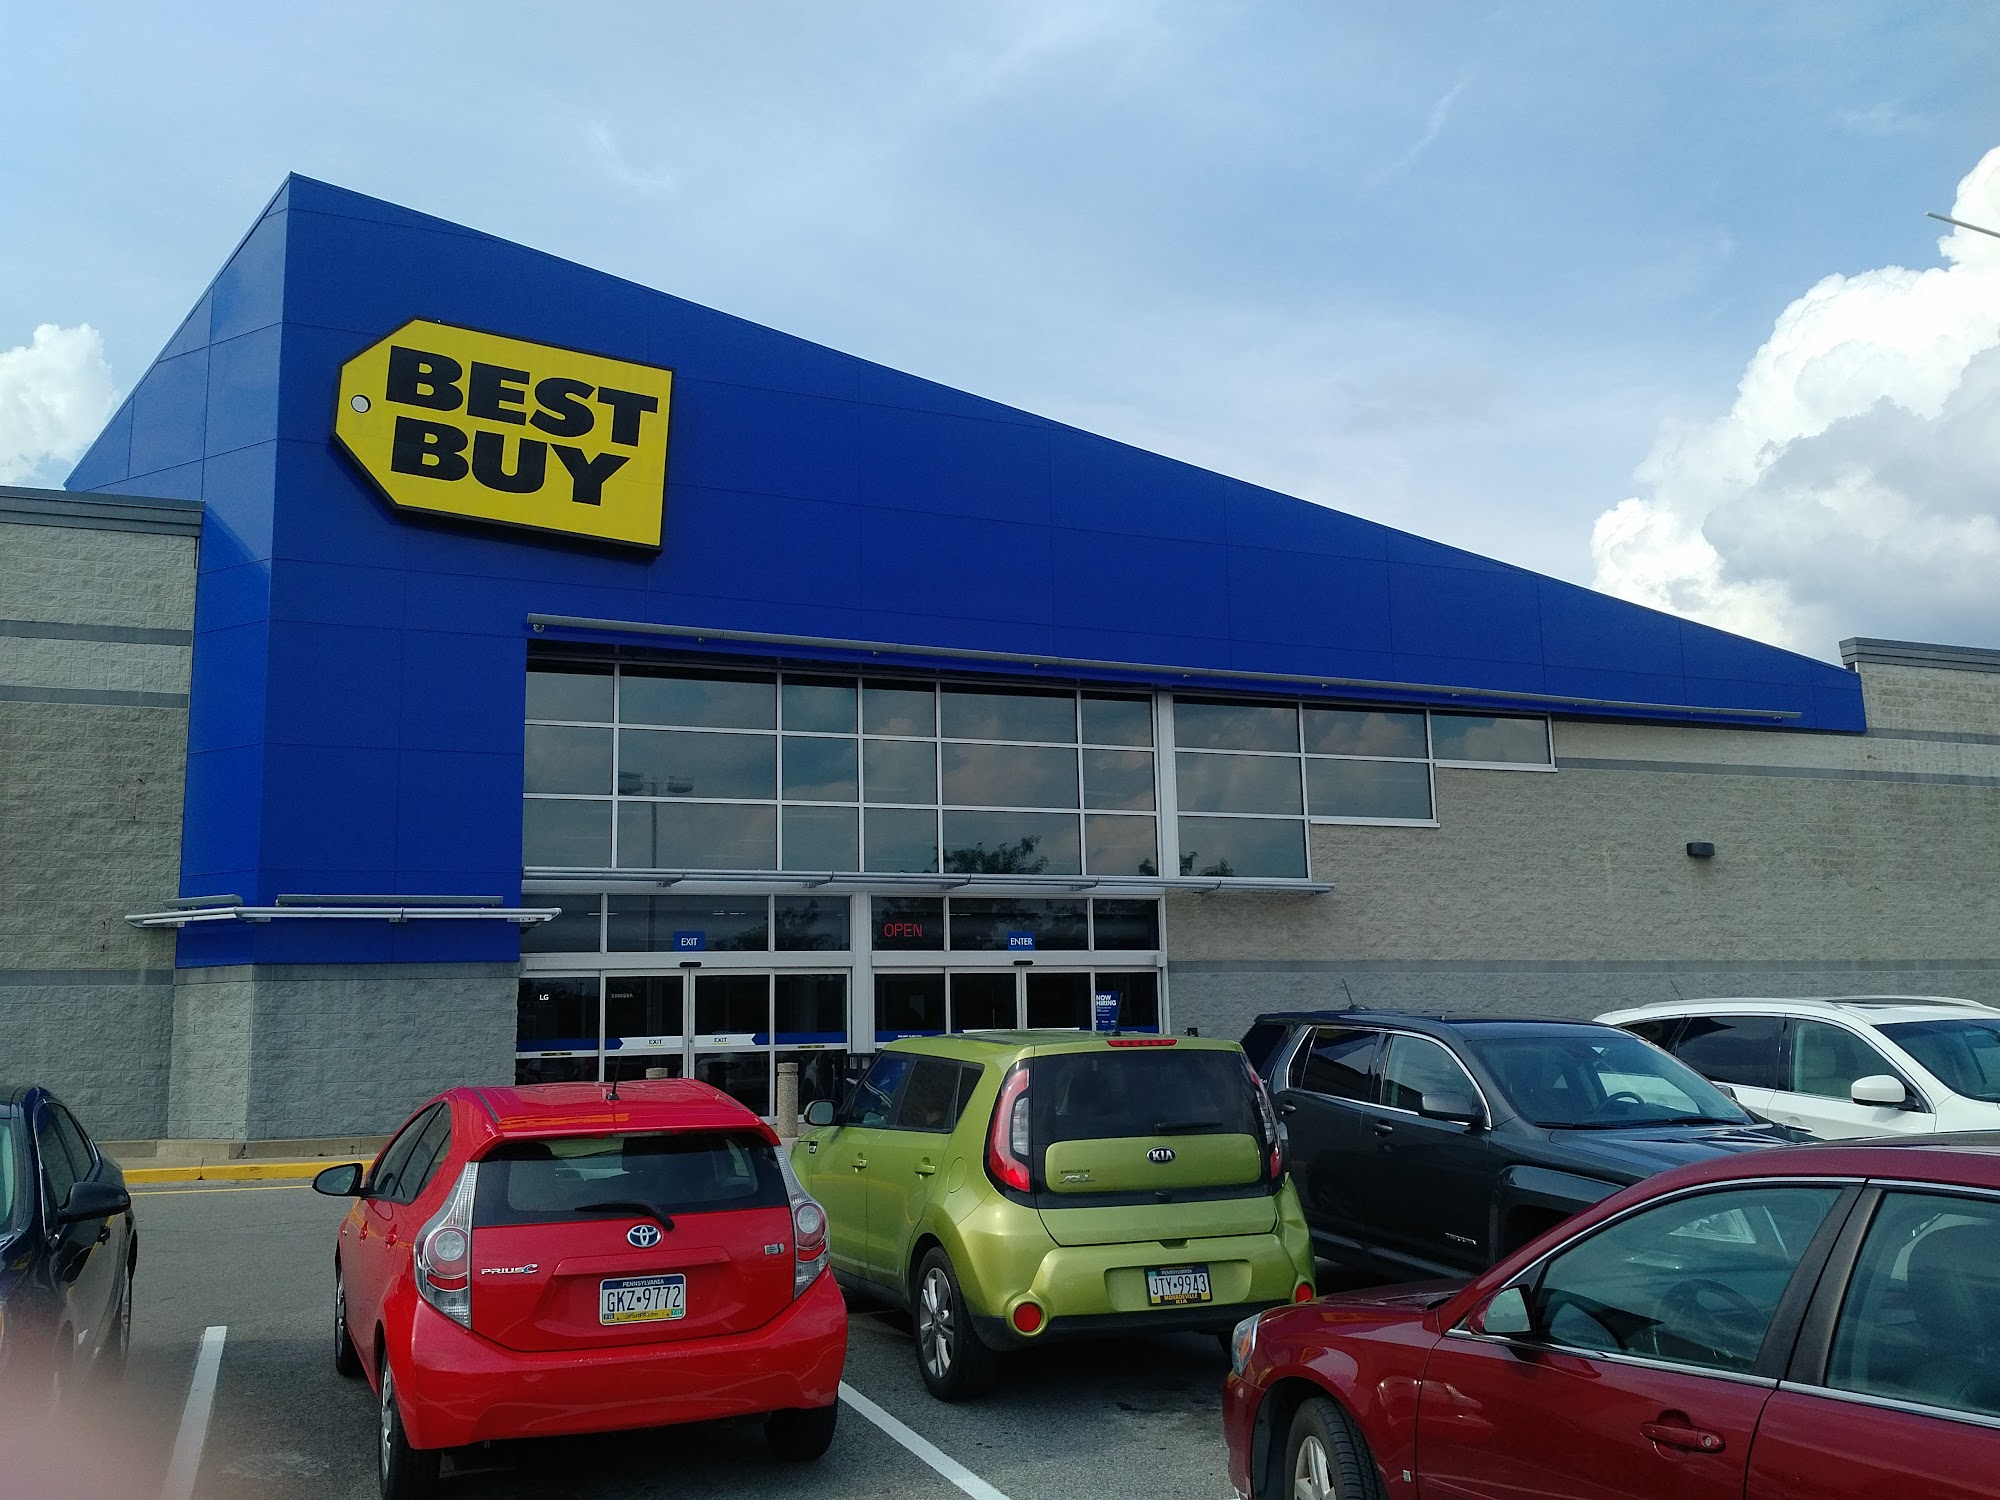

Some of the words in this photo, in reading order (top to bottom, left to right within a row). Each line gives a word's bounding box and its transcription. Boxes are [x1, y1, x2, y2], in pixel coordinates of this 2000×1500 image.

[385, 344, 659, 447] BEST
[390, 415, 631, 507] BUY
[884, 923, 923, 937] OPEN
[681, 937, 698, 946] EXIT
[1010, 937, 1033, 946] ENTER
[1152, 1150, 1173, 1161] KIA
[622, 1278, 665, 1288] PENNSYLVANIA
